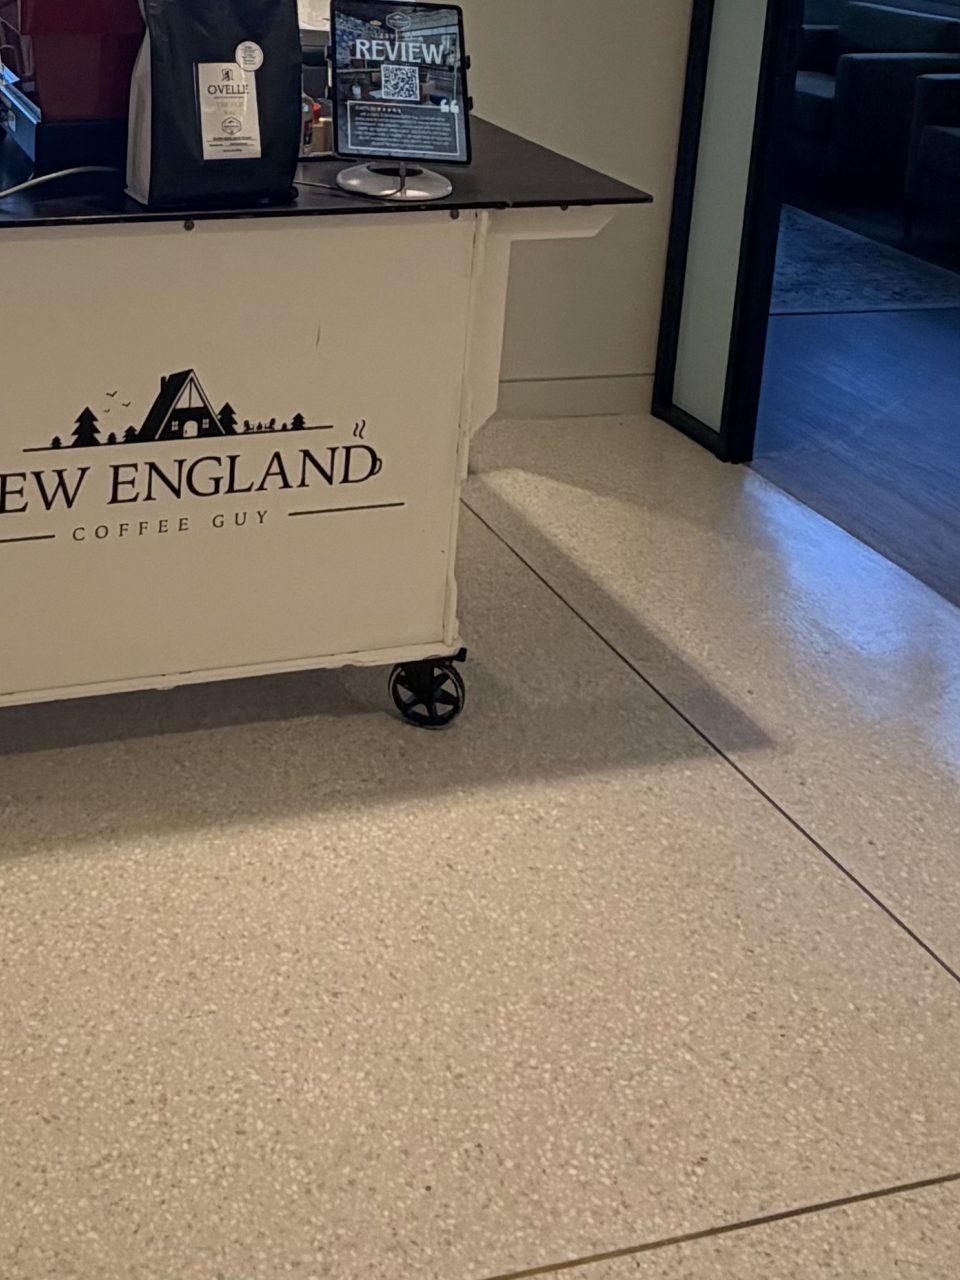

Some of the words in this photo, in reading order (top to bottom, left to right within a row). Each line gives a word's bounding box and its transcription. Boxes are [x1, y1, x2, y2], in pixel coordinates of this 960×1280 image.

[354, 38, 444, 65] REVIEW
[207, 84, 250, 95] OVELLE
[106, 443, 383, 505] ENGLAND
[72, 516, 191, 542] COFFEE
[212, 509, 271, 529] GUY
